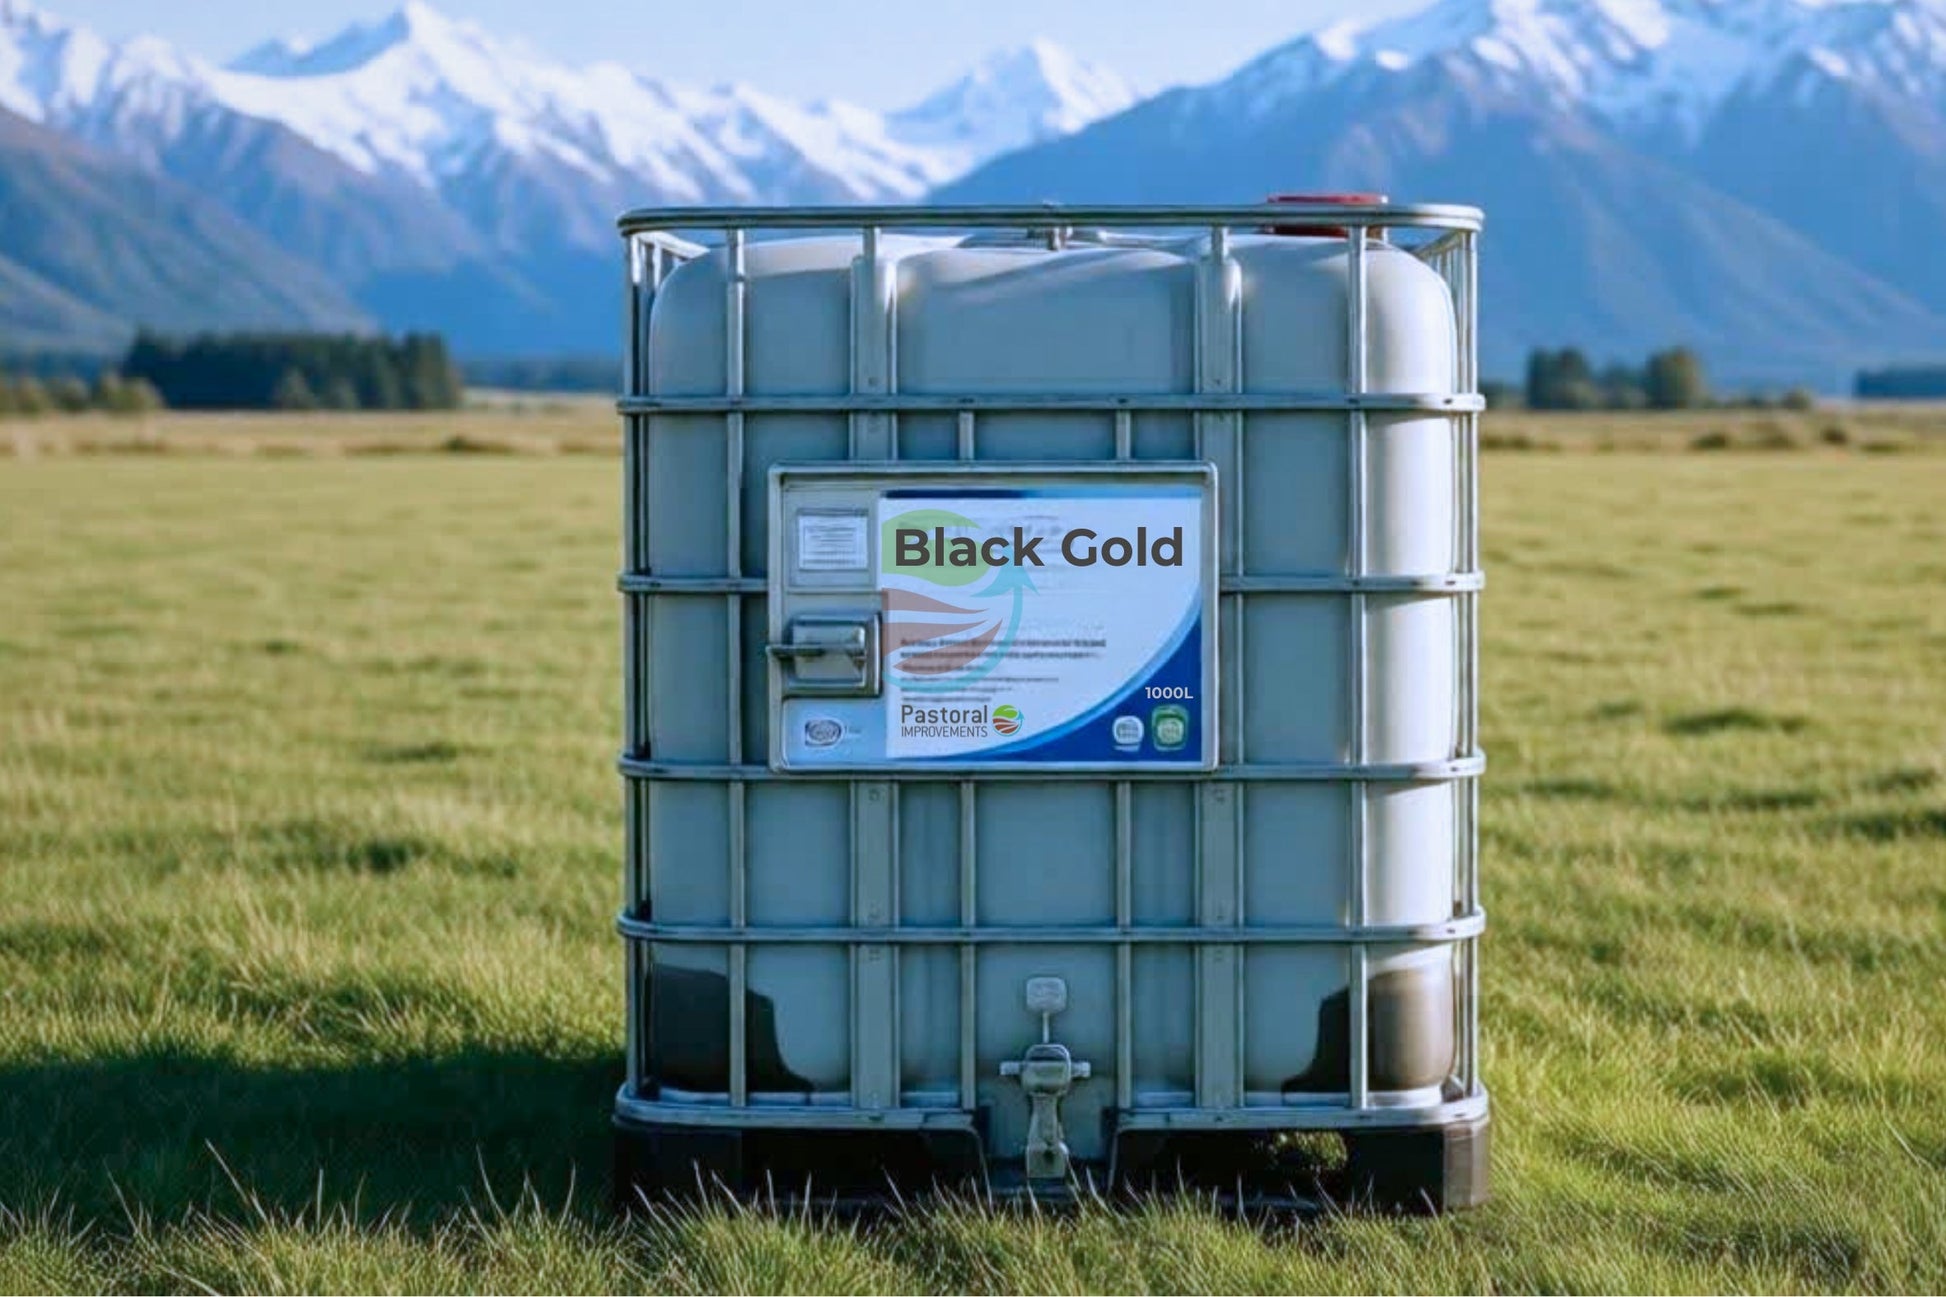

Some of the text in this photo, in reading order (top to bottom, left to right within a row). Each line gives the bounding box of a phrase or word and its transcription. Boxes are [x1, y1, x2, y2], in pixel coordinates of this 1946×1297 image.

[895, 526, 1045, 567] Black
[1061, 526, 1184, 567] Gold
[1145, 686, 1194, 700] 1000L
[901, 704, 988, 724] Pastoral
[901, 726, 988, 738] IMPROVEMENTS
